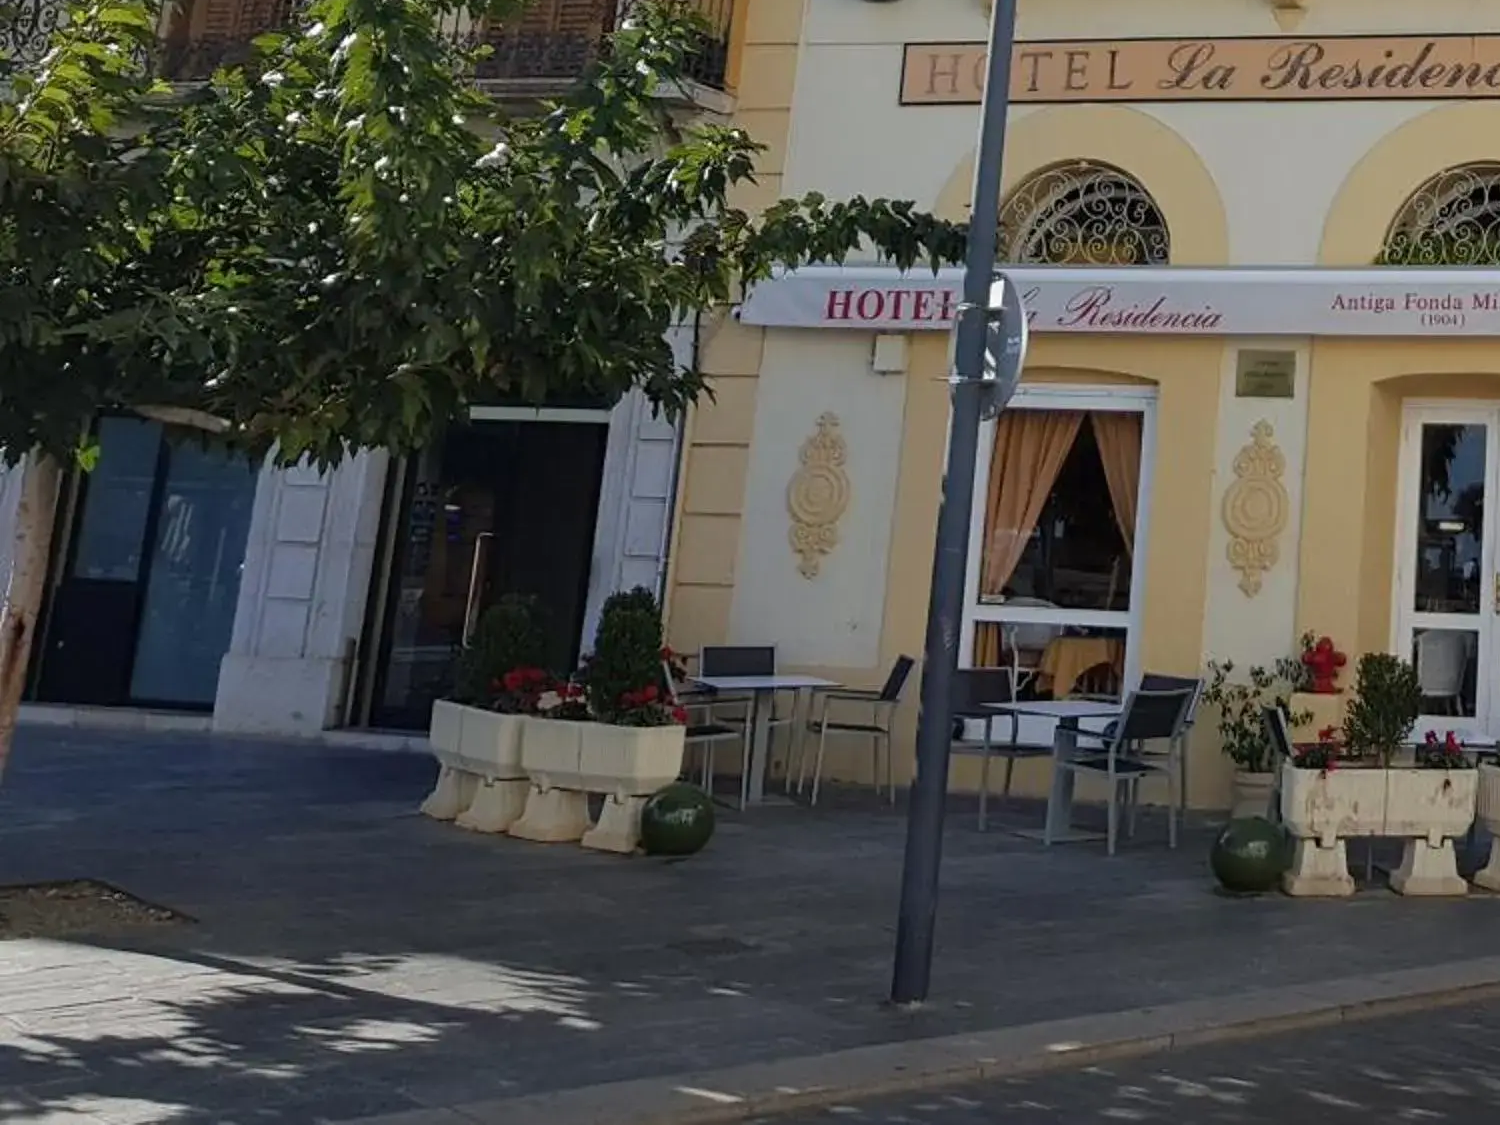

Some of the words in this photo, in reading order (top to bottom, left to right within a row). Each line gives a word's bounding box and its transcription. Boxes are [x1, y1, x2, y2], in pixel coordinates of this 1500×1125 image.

[1158, 41, 1237, 91] La
[1057, 285, 1222, 329] Residencia
[1330, 293, 1396, 314] Antiga
[1404, 293, 1463, 311] Fonda
